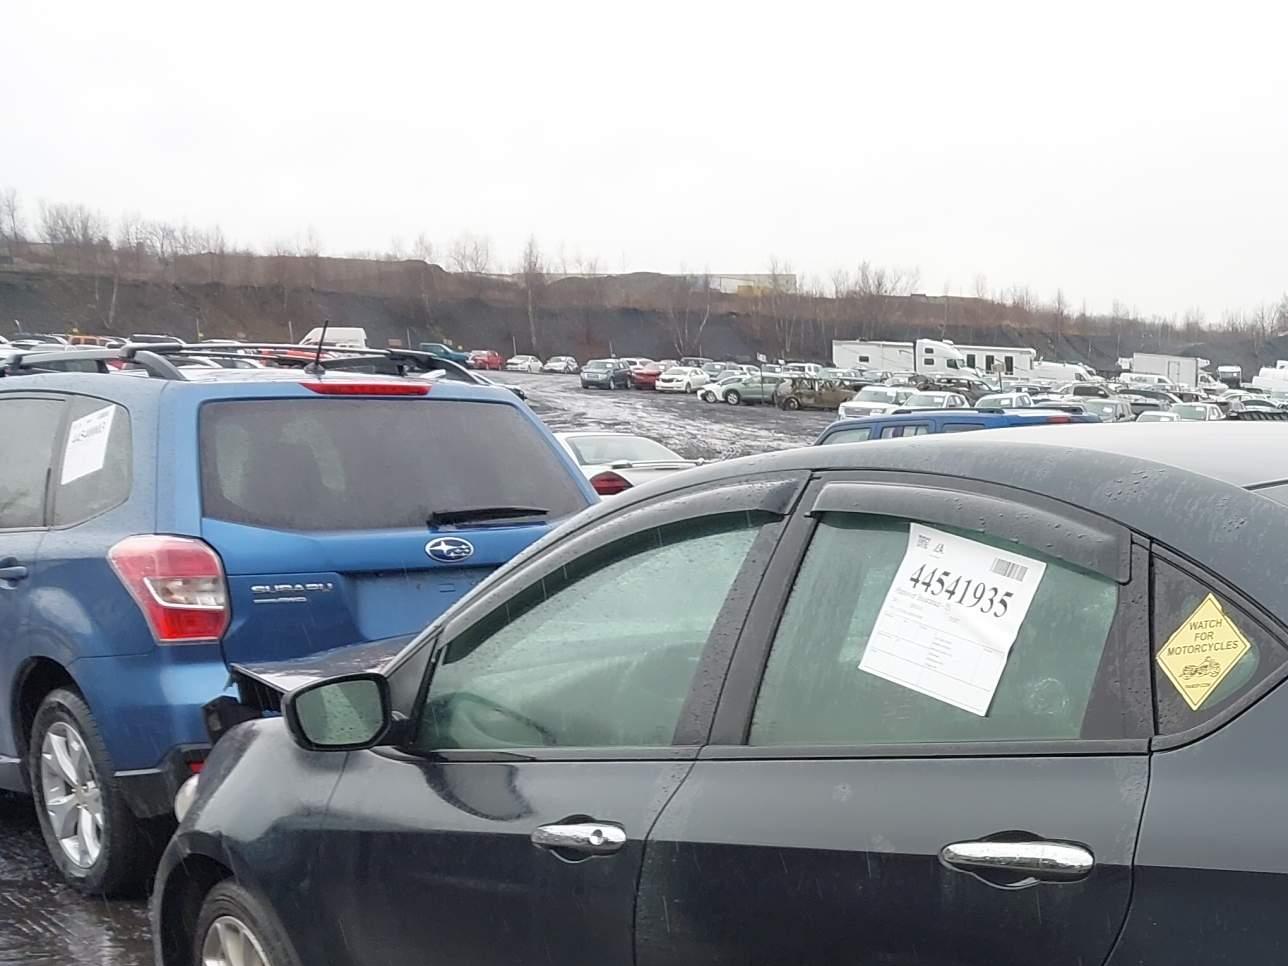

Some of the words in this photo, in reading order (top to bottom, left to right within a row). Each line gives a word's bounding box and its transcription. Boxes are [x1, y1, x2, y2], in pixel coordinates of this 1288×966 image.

[909, 563, 1015, 618] 44541935
[1189, 618, 1223, 631] WATCH
[1194, 631, 1215, 641] FOR
[1167, 640, 1239, 657] MOTORCYCLES
